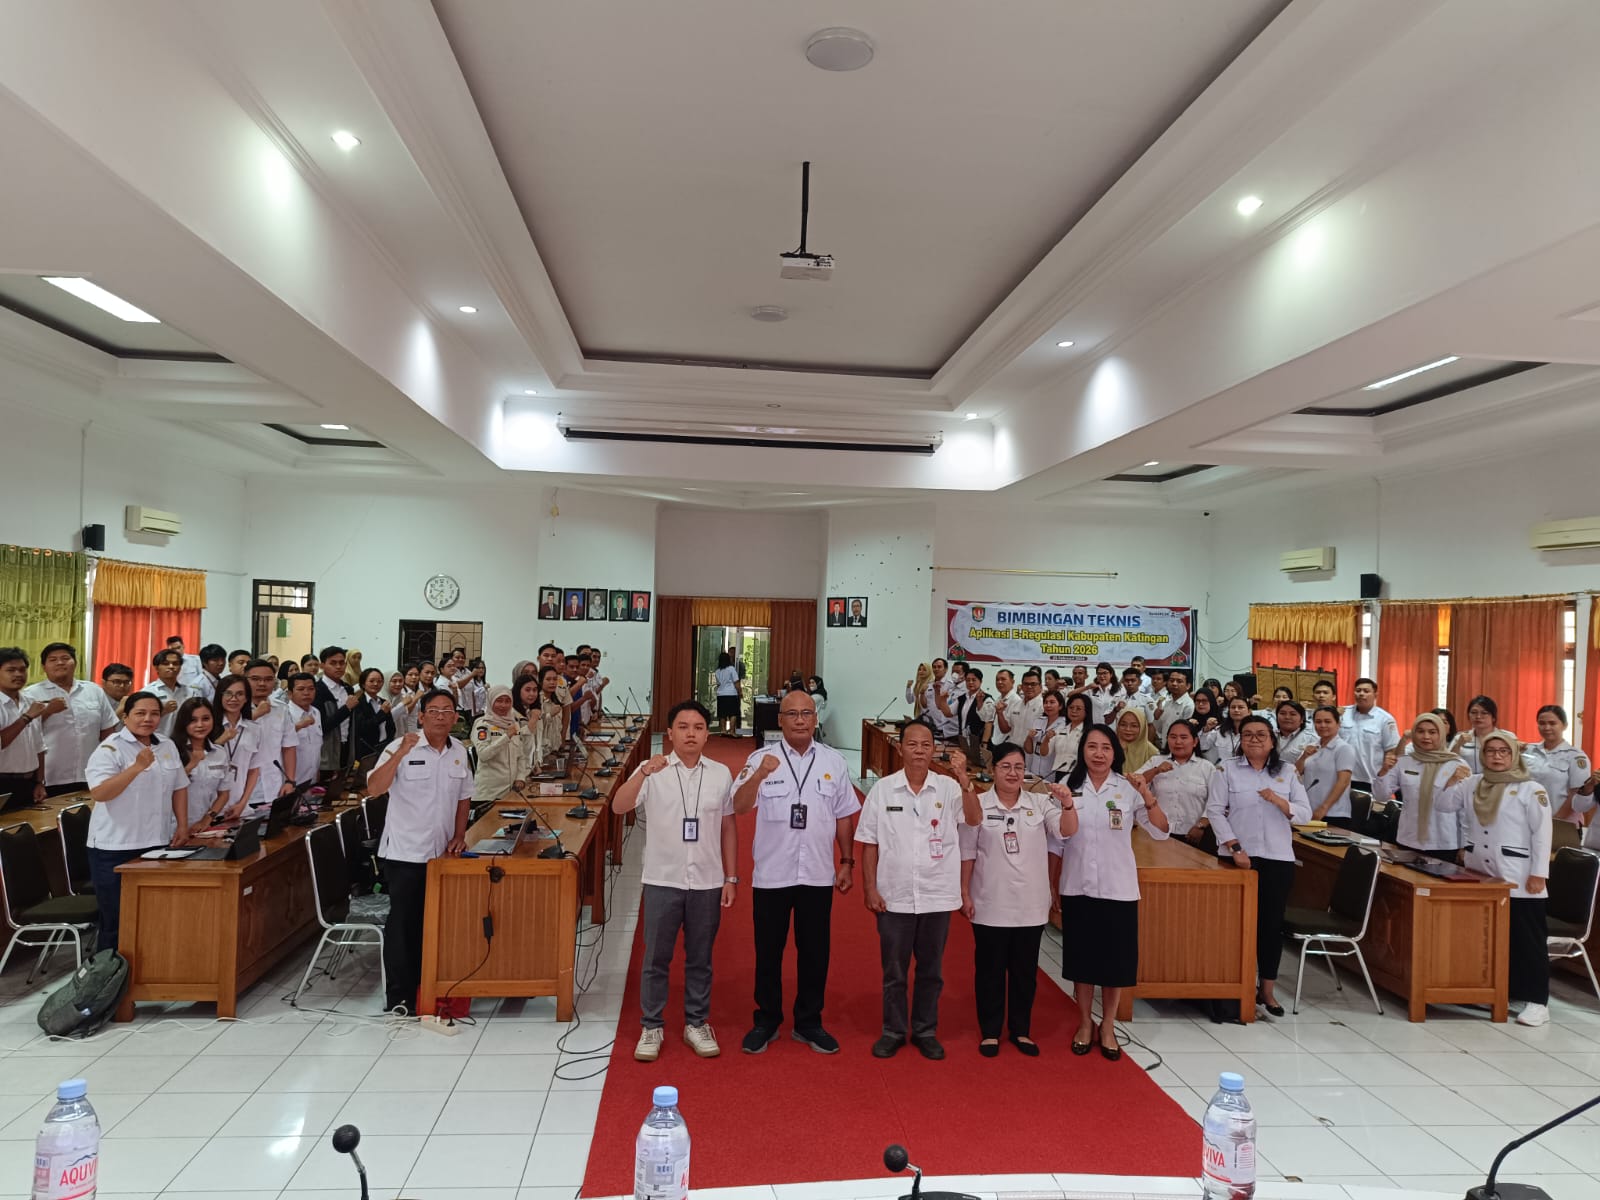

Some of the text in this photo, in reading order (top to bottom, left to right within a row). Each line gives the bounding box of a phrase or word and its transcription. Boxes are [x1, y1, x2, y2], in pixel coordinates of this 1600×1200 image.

[997, 611, 1141, 627] BIMBINGAN TEKNIS
[969, 627, 1169, 645] Aplikasi E-Regulasi Kabupaten Katingan
[1041, 643, 1099, 656] Tahun 2026
